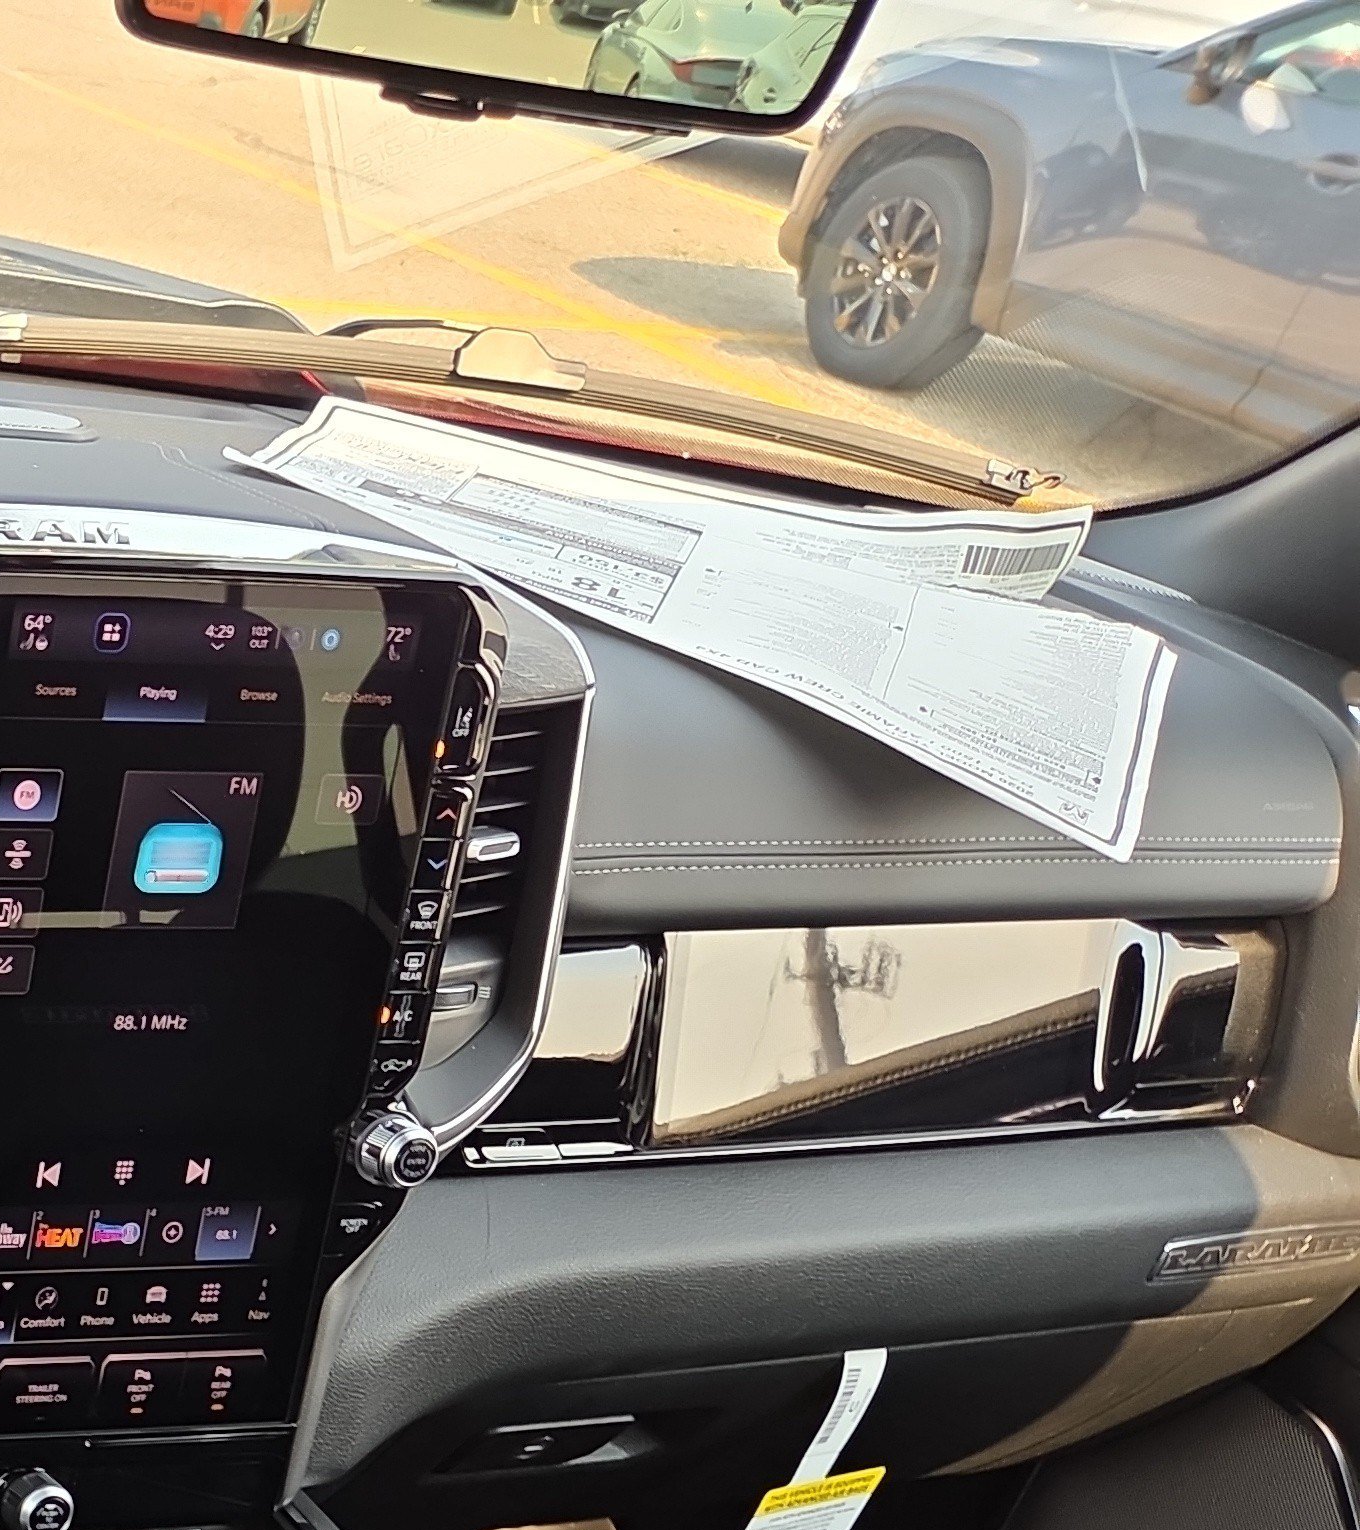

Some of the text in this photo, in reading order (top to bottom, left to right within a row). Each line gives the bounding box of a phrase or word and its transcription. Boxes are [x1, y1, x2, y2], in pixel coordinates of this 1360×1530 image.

[570, 576, 626, 601] 18
[205, 623, 235, 639] 4:29
[249, 638, 270, 648] OUT
[35, 683, 77, 697] Sources
[139, 685, 178, 701] Playing
[784, 672, 846, 701] CREW
[240, 687, 278, 702] Browse
[321, 691, 393, 707] Audio Settings
[228, 776, 259, 797] FM
[18, 789, 36, 801] FM
[409, 919, 439, 931] FRONT
[399, 971, 423, 982] REAR
[112, 1013, 189, 1031] 88.1 MHz
[36, 1228, 84, 1248] HEAT
[20, 1315, 66, 1329] Comfort
[80, 1315, 116, 1327] Phone
[132, 1312, 173, 1325] Vehicle
[190, 1311, 220, 1325] Apps
[247, 1309, 272, 1321] Nav
